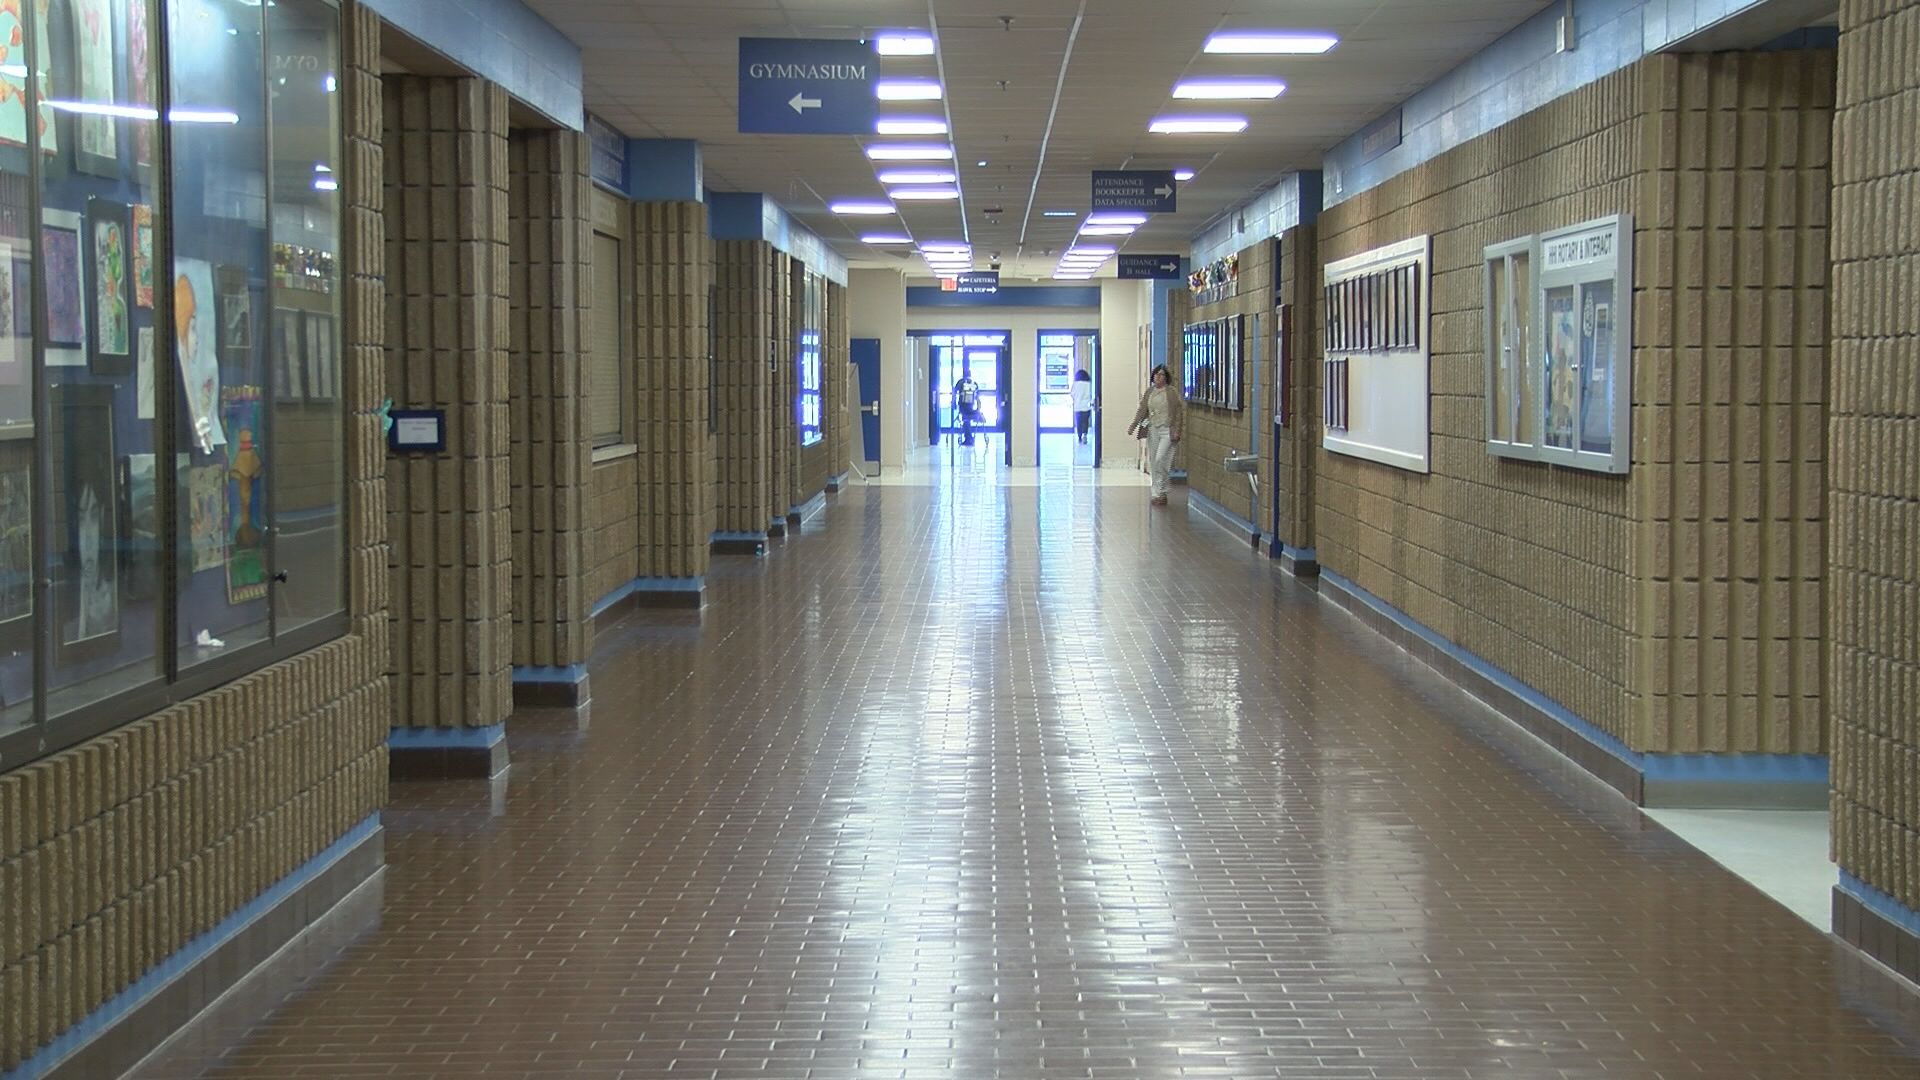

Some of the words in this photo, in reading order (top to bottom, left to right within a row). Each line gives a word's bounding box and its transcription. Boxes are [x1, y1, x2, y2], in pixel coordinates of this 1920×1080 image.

[750, 63, 866, 80] GYMNASIUM
[1095, 178, 1143, 186] ATTENDANCE
[1095, 187, 1144, 195] BOOKKEEPER
[1095, 198, 1114, 206] DATA
[1116, 198, 1157, 206] SPECIALIST
[1557, 241, 1578, 263] ROTARY
[1584, 233, 1612, 258] INTERACT
[1120, 258, 1156, 266] GUIDANCE
